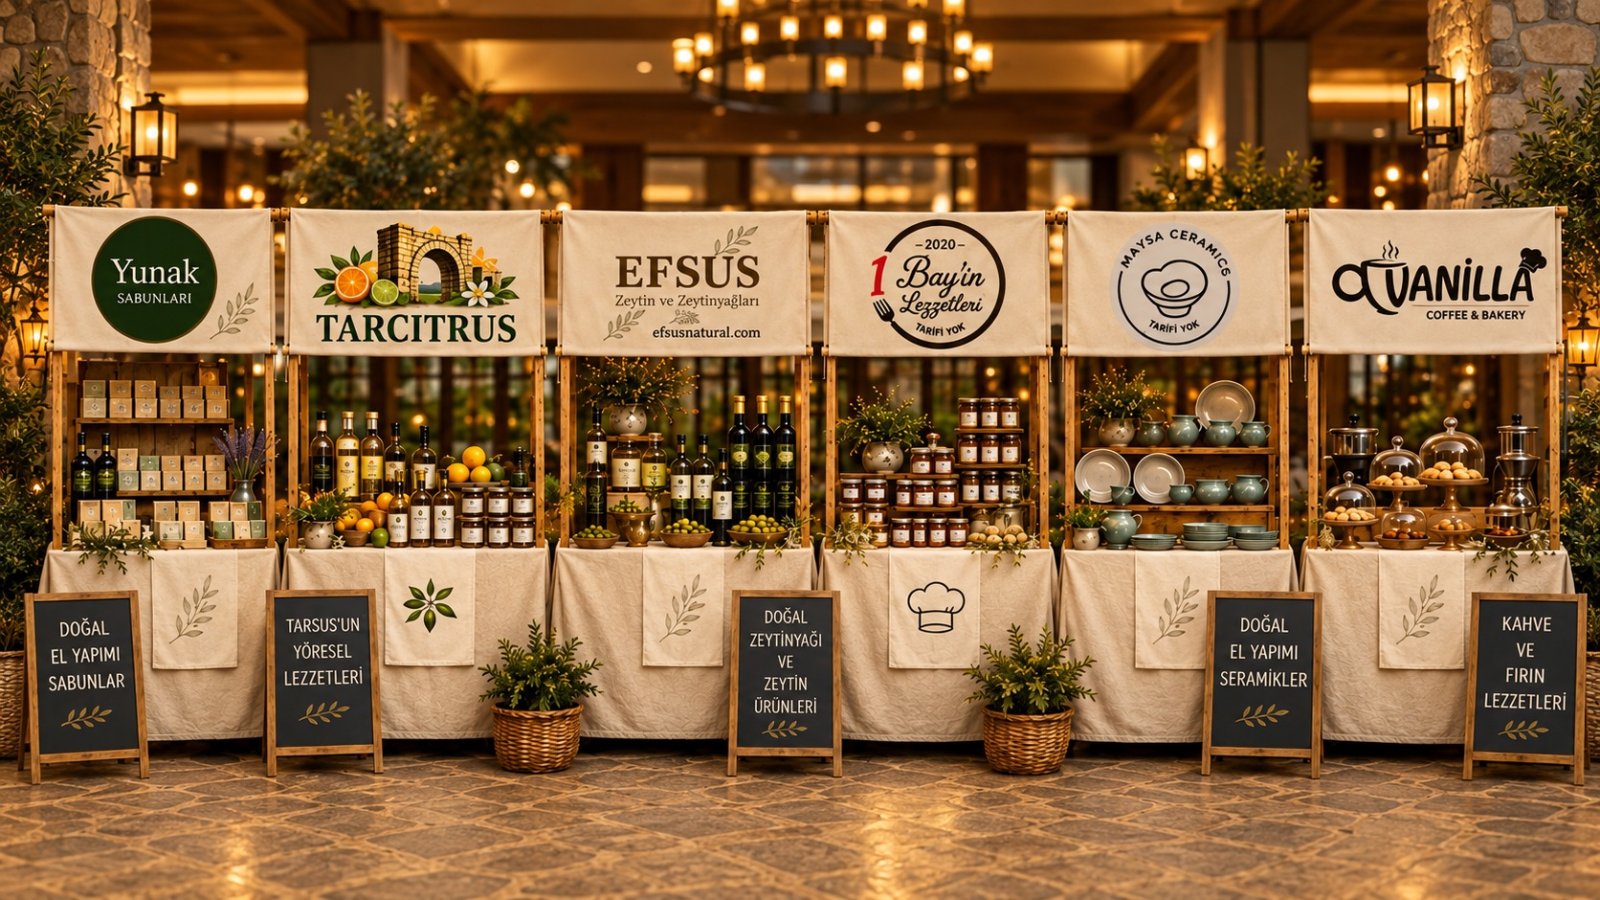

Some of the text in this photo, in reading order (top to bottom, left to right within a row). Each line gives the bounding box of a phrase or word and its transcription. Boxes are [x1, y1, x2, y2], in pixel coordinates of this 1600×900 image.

[924, 239, 956, 250] 2020
[1120, 231, 1165, 269] MAYSA
[110, 258, 200, 284] Yunak
[615, 255, 760, 288] EFSUS
[870, 254, 985, 298] 1 Bay'in
[117, 292, 192, 304] SABUNLARI
[615, 294, 760, 310] Zeytin ve Zeytinyağları
[899, 290, 983, 320] Lezzetleri
[1426, 310, 1526, 321] COFFEE & BAKERY
[315, 314, 517, 343] TARCITRUS
[652, 325, 761, 339] efsusnatural.com
[915, 322, 966, 337] TARİFİ YOK
[1148, 319, 1201, 334] TARİFİ YOK
[764, 607, 808, 624] DOĞAL
[1240, 614, 1289, 634] DOĞAL
[1502, 616, 1552, 632] KAHVE
[59, 617, 110, 637] DOĞAL
[286, 617, 361, 633] TARSUS'UN
[749, 630, 822, 648] ZEYTİNYAĞI
[51, 646, 121, 665] EL YAPIMI
[293, 641, 352, 660] YÖRESEL
[1230, 644, 1299, 661] EL YAPIMI
[1516, 642, 1535, 658] VE
[777, 655, 794, 669] VE
[48, 673, 126, 692] SABUNLAR
[284, 666, 364, 687] LEZZETLERİ
[763, 674, 808, 691] ZEYTİN
[1219, 668, 1308, 688] SERAMİKLER
[1505, 667, 1545, 684] FIRIN
[754, 696, 817, 714] ÜRÜNLERİ
[1484, 692, 1567, 711] LEZZETLERİ
